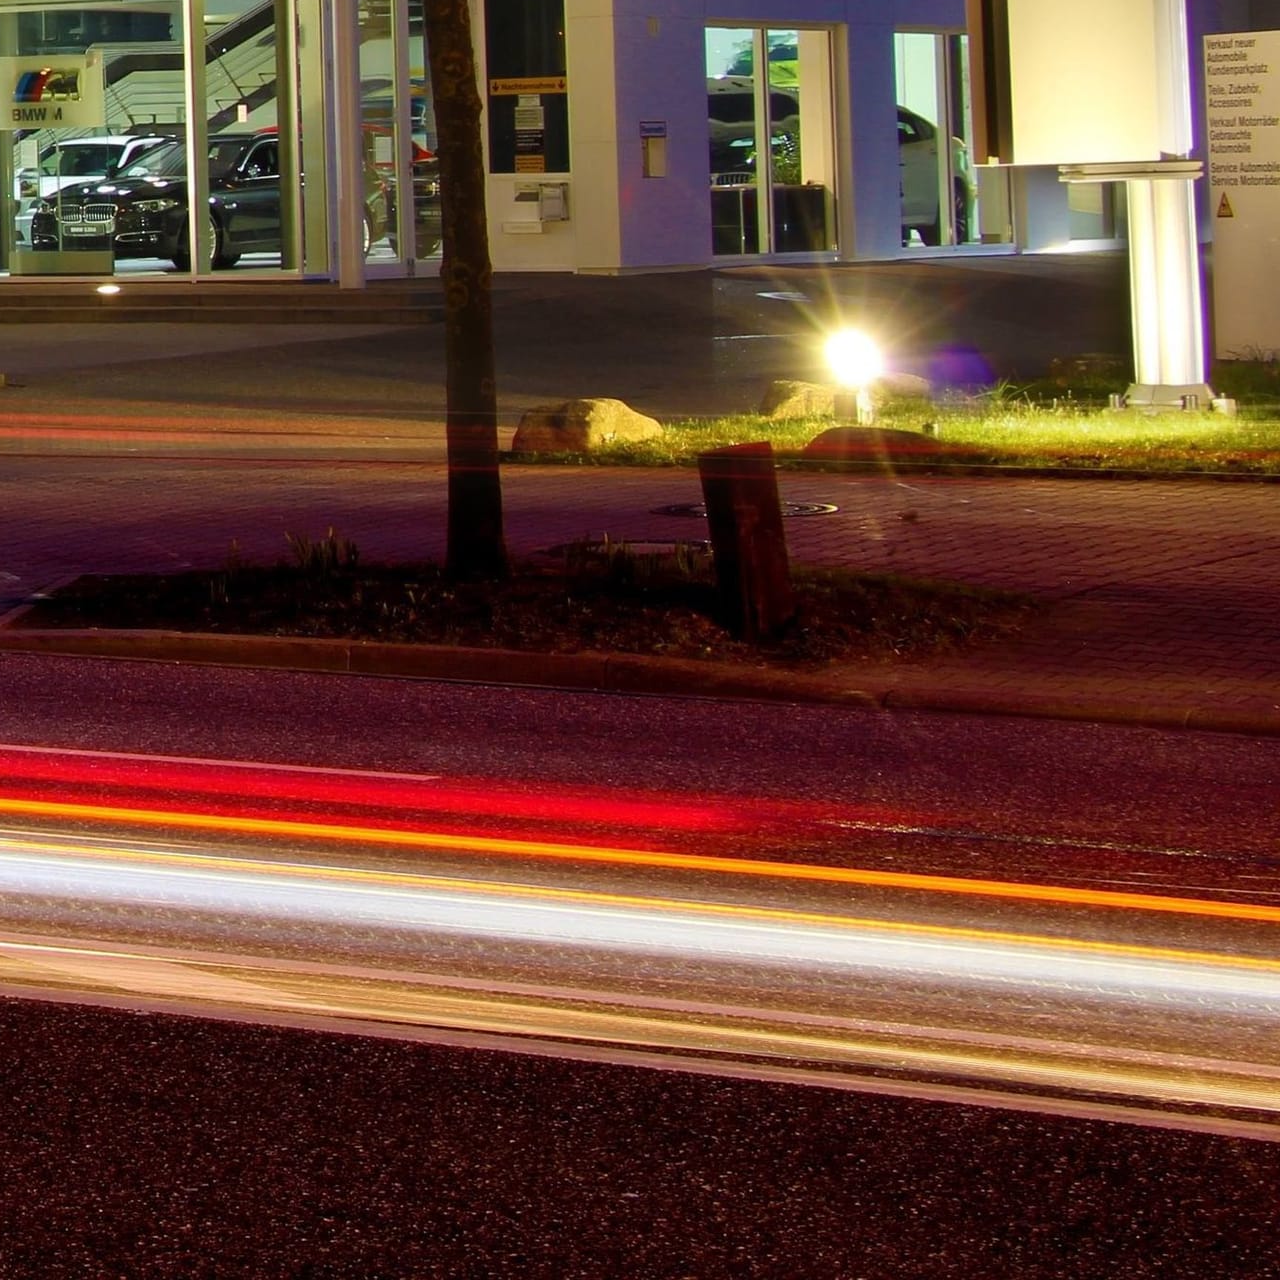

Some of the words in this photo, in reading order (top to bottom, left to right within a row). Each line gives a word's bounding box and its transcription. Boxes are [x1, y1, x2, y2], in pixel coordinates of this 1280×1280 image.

[1208, 39, 1233, 49] Verkauf
[1235, 39, 1256, 48] neuer
[1207, 51, 1247, 62] Automobile
[1208, 64, 1268, 75] Kundenparkplatz
[12, 108, 47, 121] BMW
[1211, 144, 1251, 153] Automobile
[1211, 162, 1238, 173] Service
[1212, 176, 1238, 186] Service
